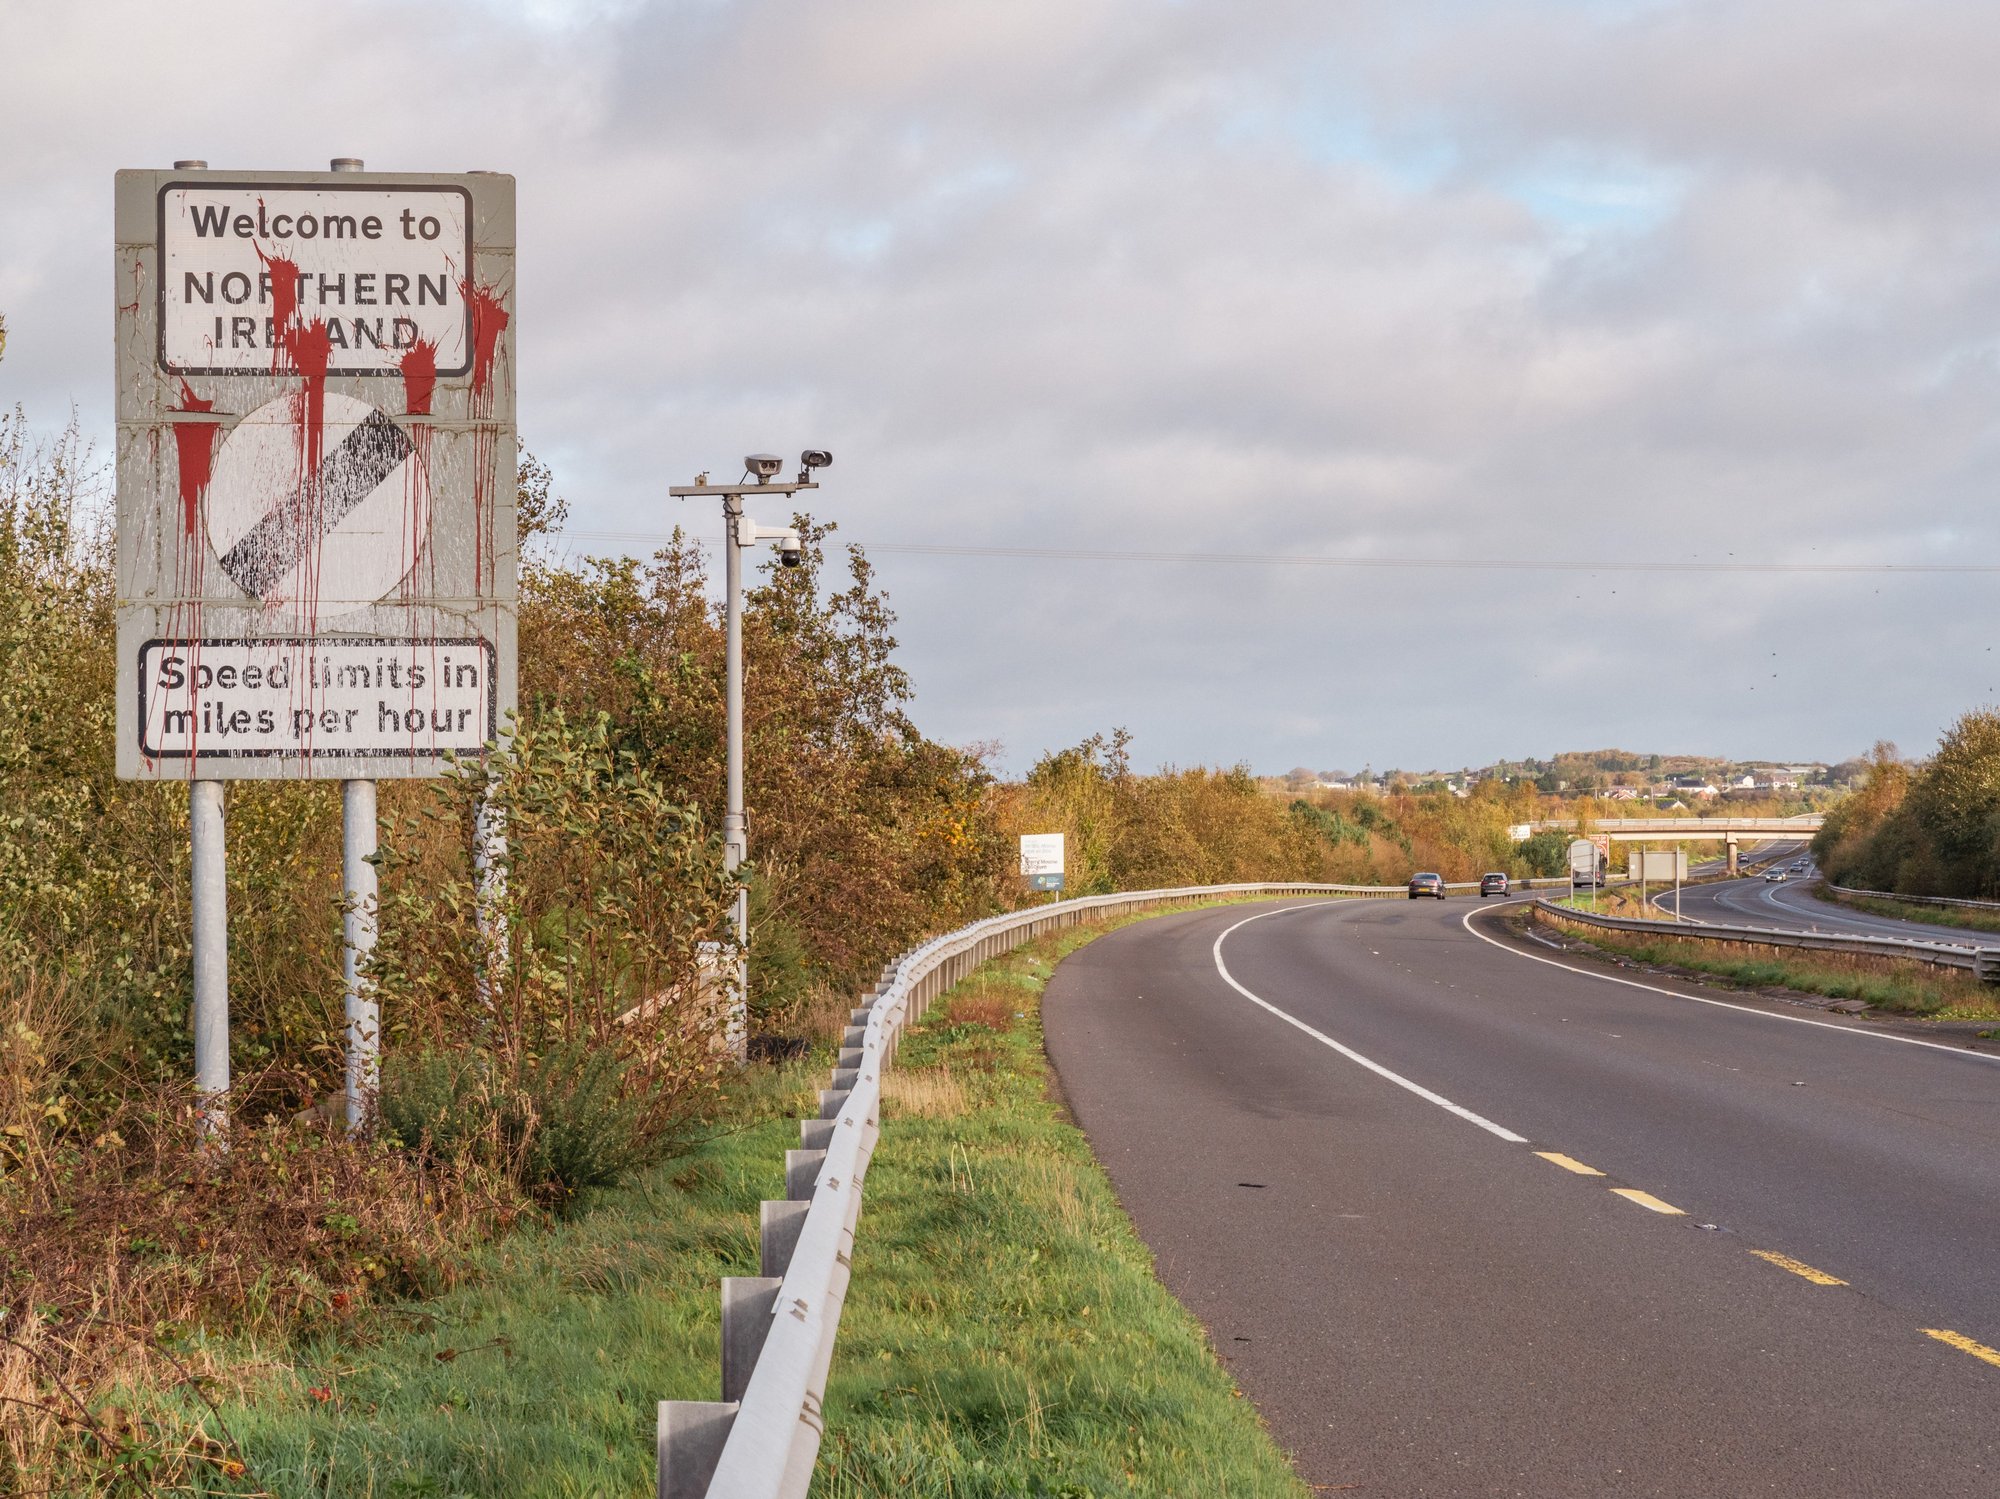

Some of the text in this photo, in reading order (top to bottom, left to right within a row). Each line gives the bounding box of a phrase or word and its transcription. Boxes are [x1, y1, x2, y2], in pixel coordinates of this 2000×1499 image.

[190, 205, 441, 241] Welcome to
[215, 316, 418, 349] IREAND
[158, 656, 478, 695] Speed limits in
[164, 700, 472, 739] miles per hour
